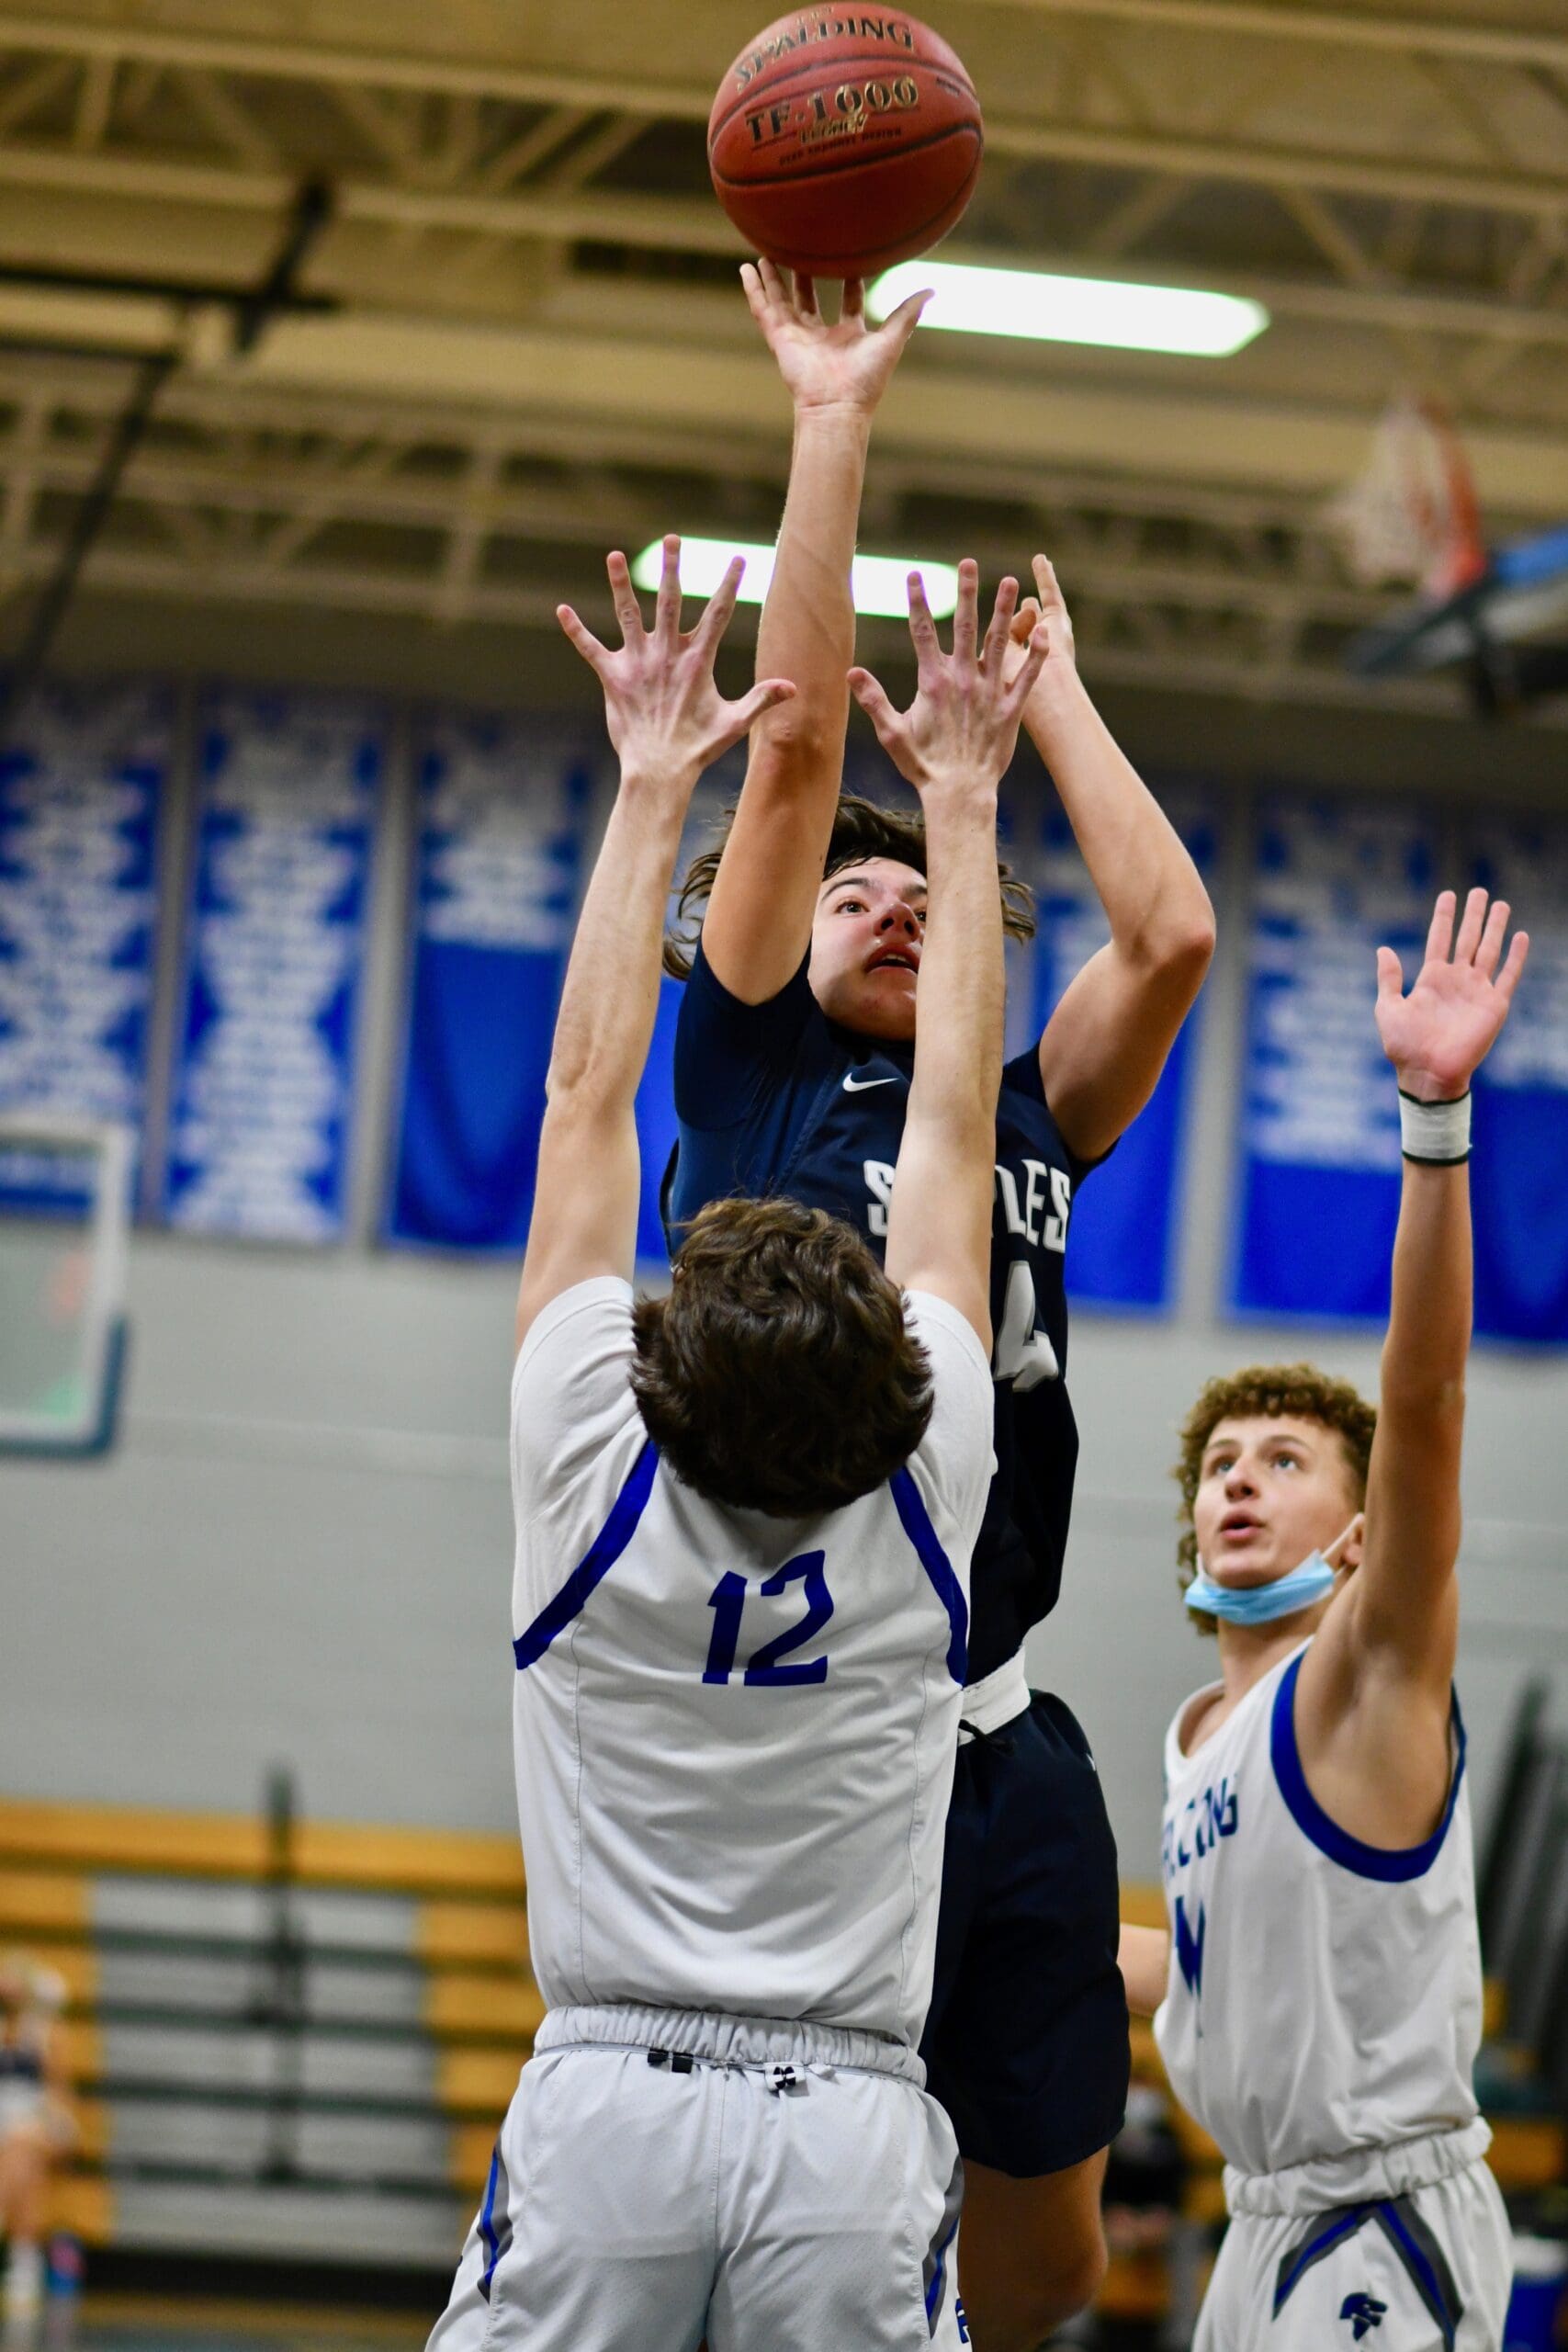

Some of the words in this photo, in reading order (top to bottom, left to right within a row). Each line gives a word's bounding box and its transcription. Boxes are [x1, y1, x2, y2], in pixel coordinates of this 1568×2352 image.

[736, 17, 914, 95] SPALDING
[863, 1159, 1071, 1255] SLES
[702, 1549, 835, 1687] 12
